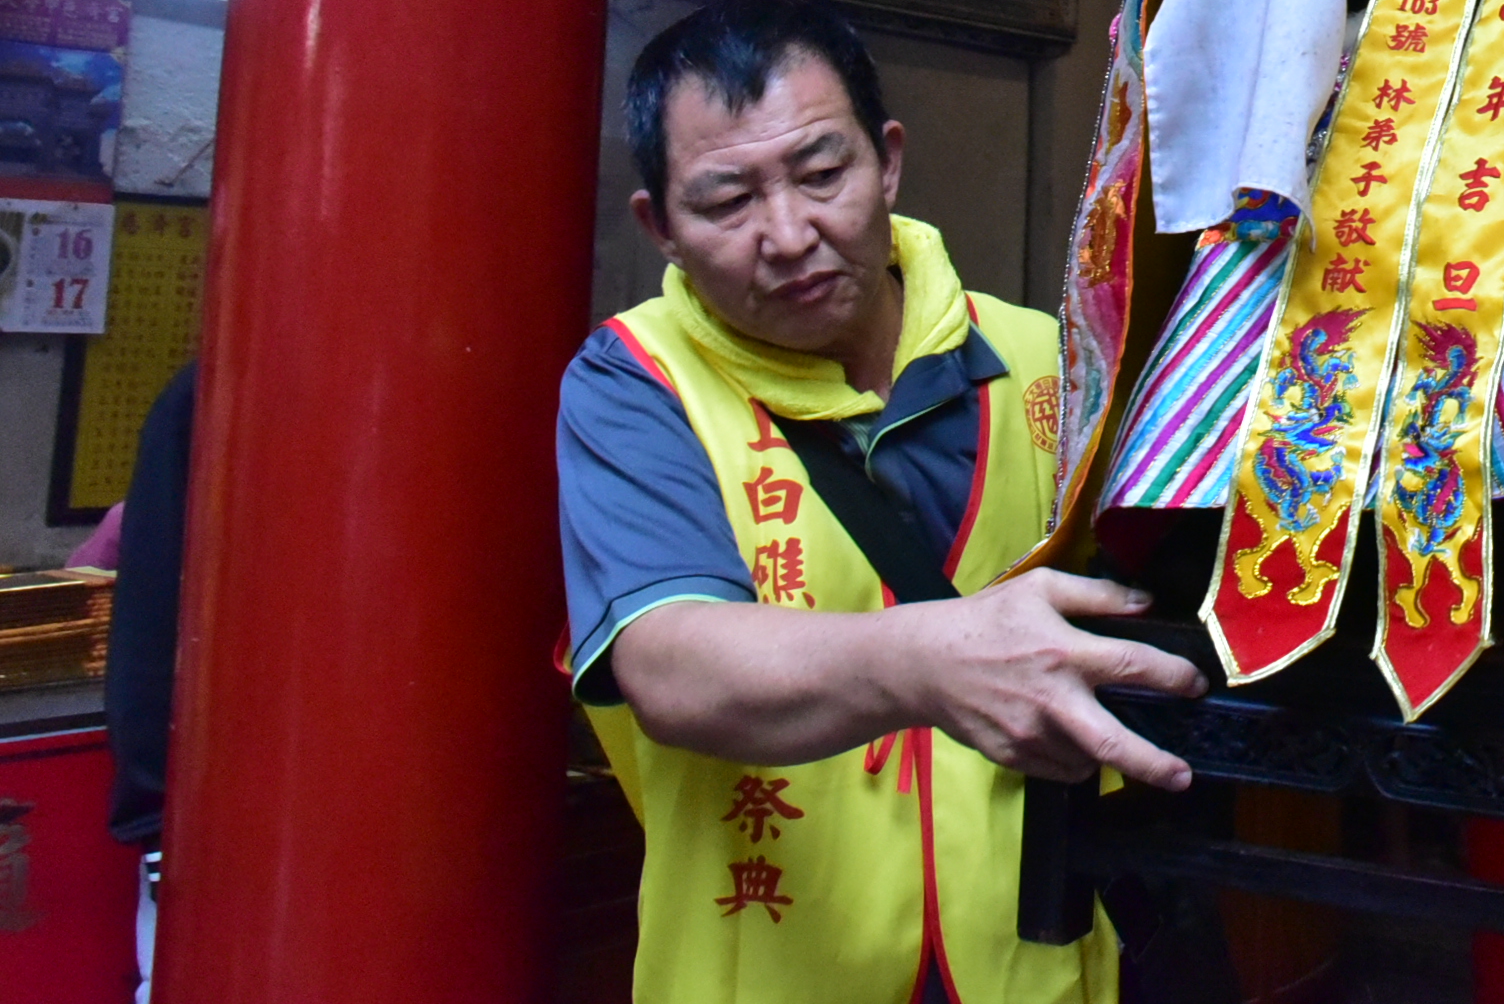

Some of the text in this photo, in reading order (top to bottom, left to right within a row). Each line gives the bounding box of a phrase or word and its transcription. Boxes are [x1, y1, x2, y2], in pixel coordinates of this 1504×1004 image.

[58, 228, 93, 261] 16
[52, 278, 90, 309] 17
[714, 774, 804, 923] 祭典
